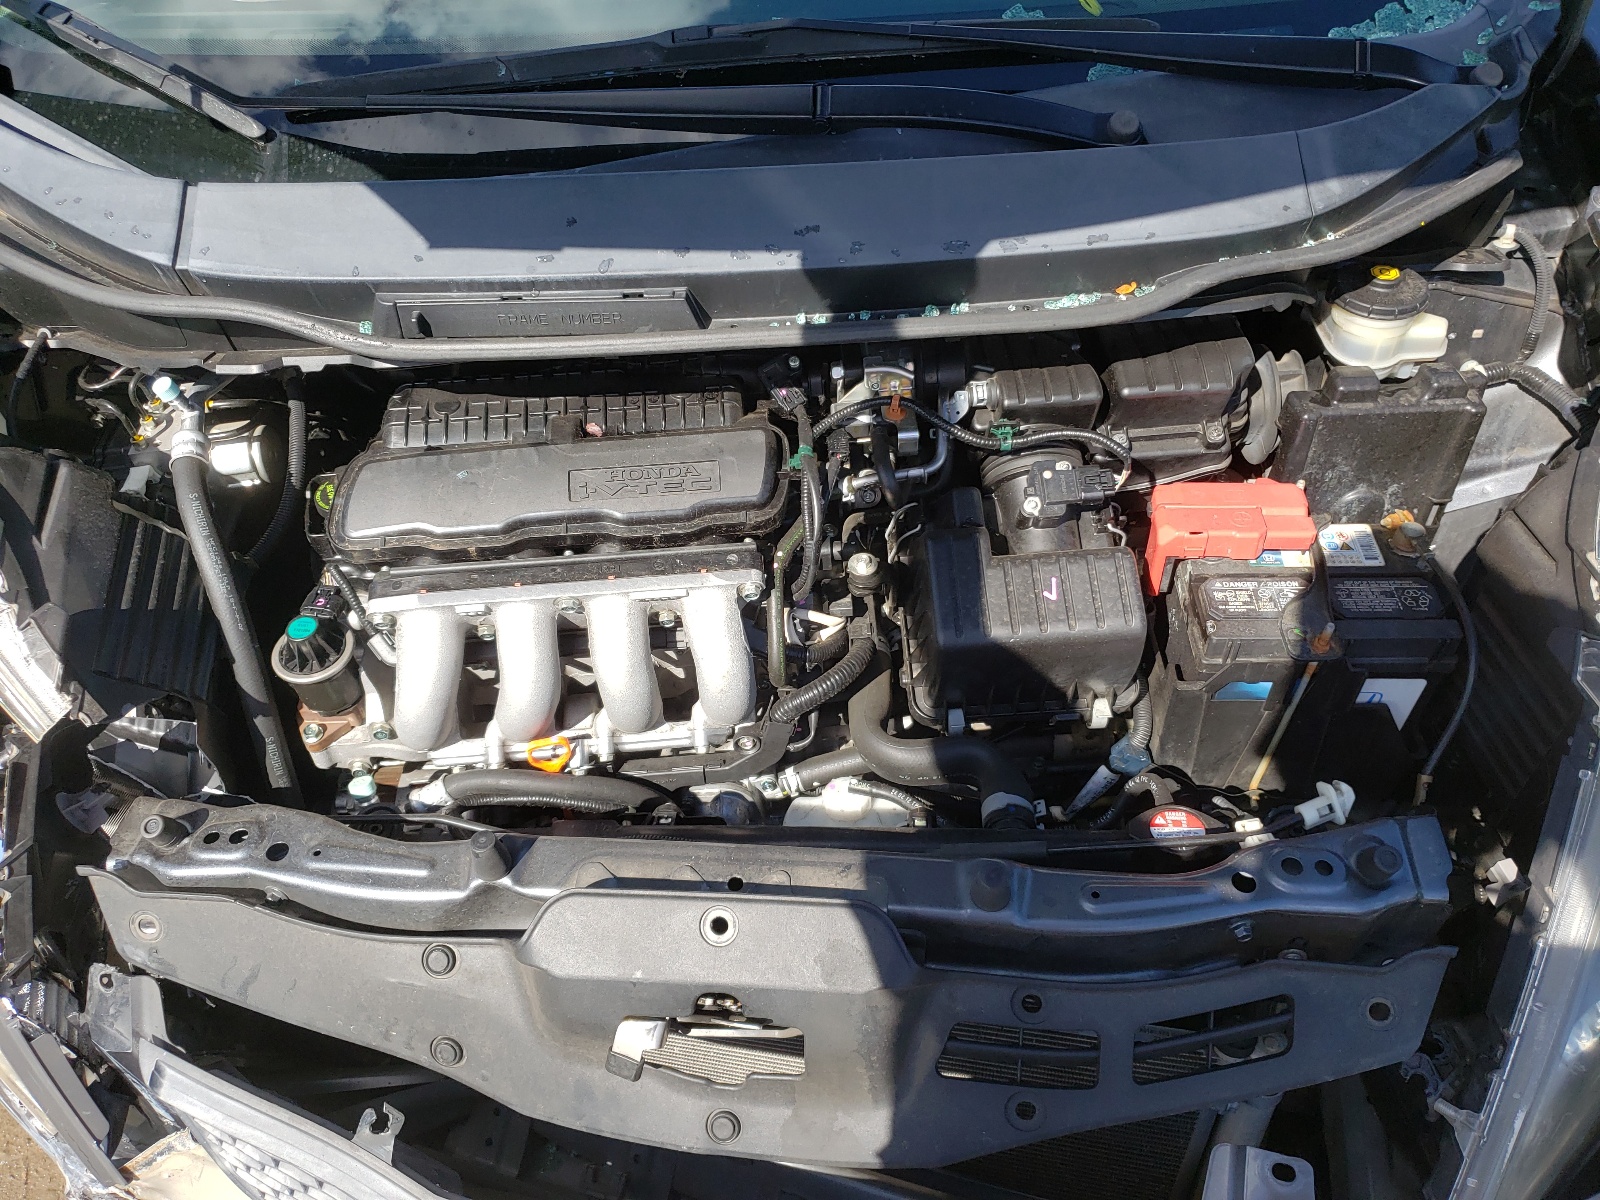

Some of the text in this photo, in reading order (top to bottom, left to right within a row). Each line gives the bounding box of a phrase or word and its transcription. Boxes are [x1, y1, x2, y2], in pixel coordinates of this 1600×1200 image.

[497, 311, 622, 325] FRAME NUMBER
[604, 465, 701, 482] HONDA
